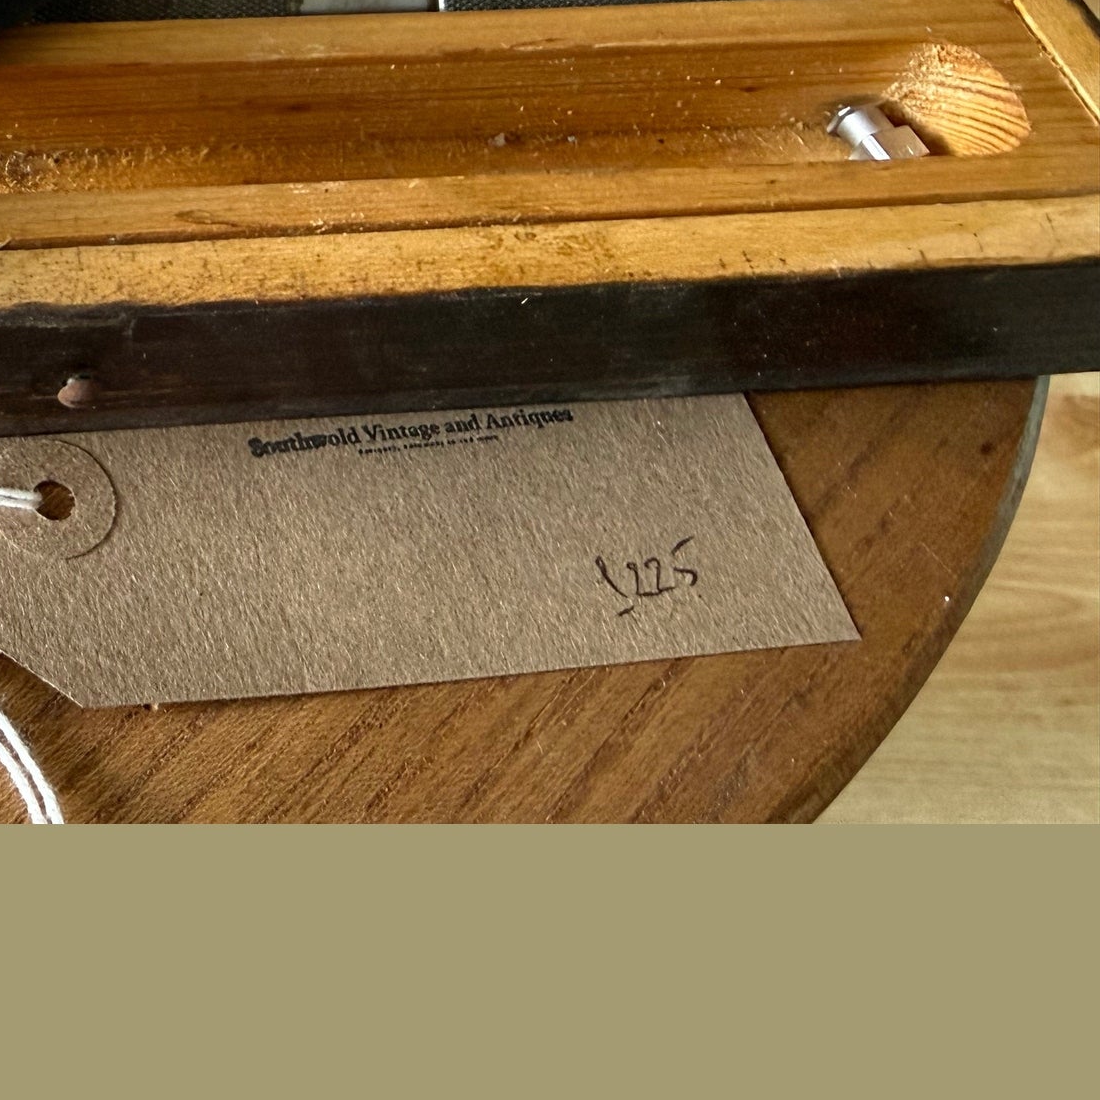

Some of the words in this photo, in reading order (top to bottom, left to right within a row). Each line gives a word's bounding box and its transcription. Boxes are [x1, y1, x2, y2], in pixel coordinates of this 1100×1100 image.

[248, 425, 362, 459] Southwold
[361, 421, 442, 445] Vintage
[444, 414, 483, 435] and
[485, 407, 575, 431] Antiques
